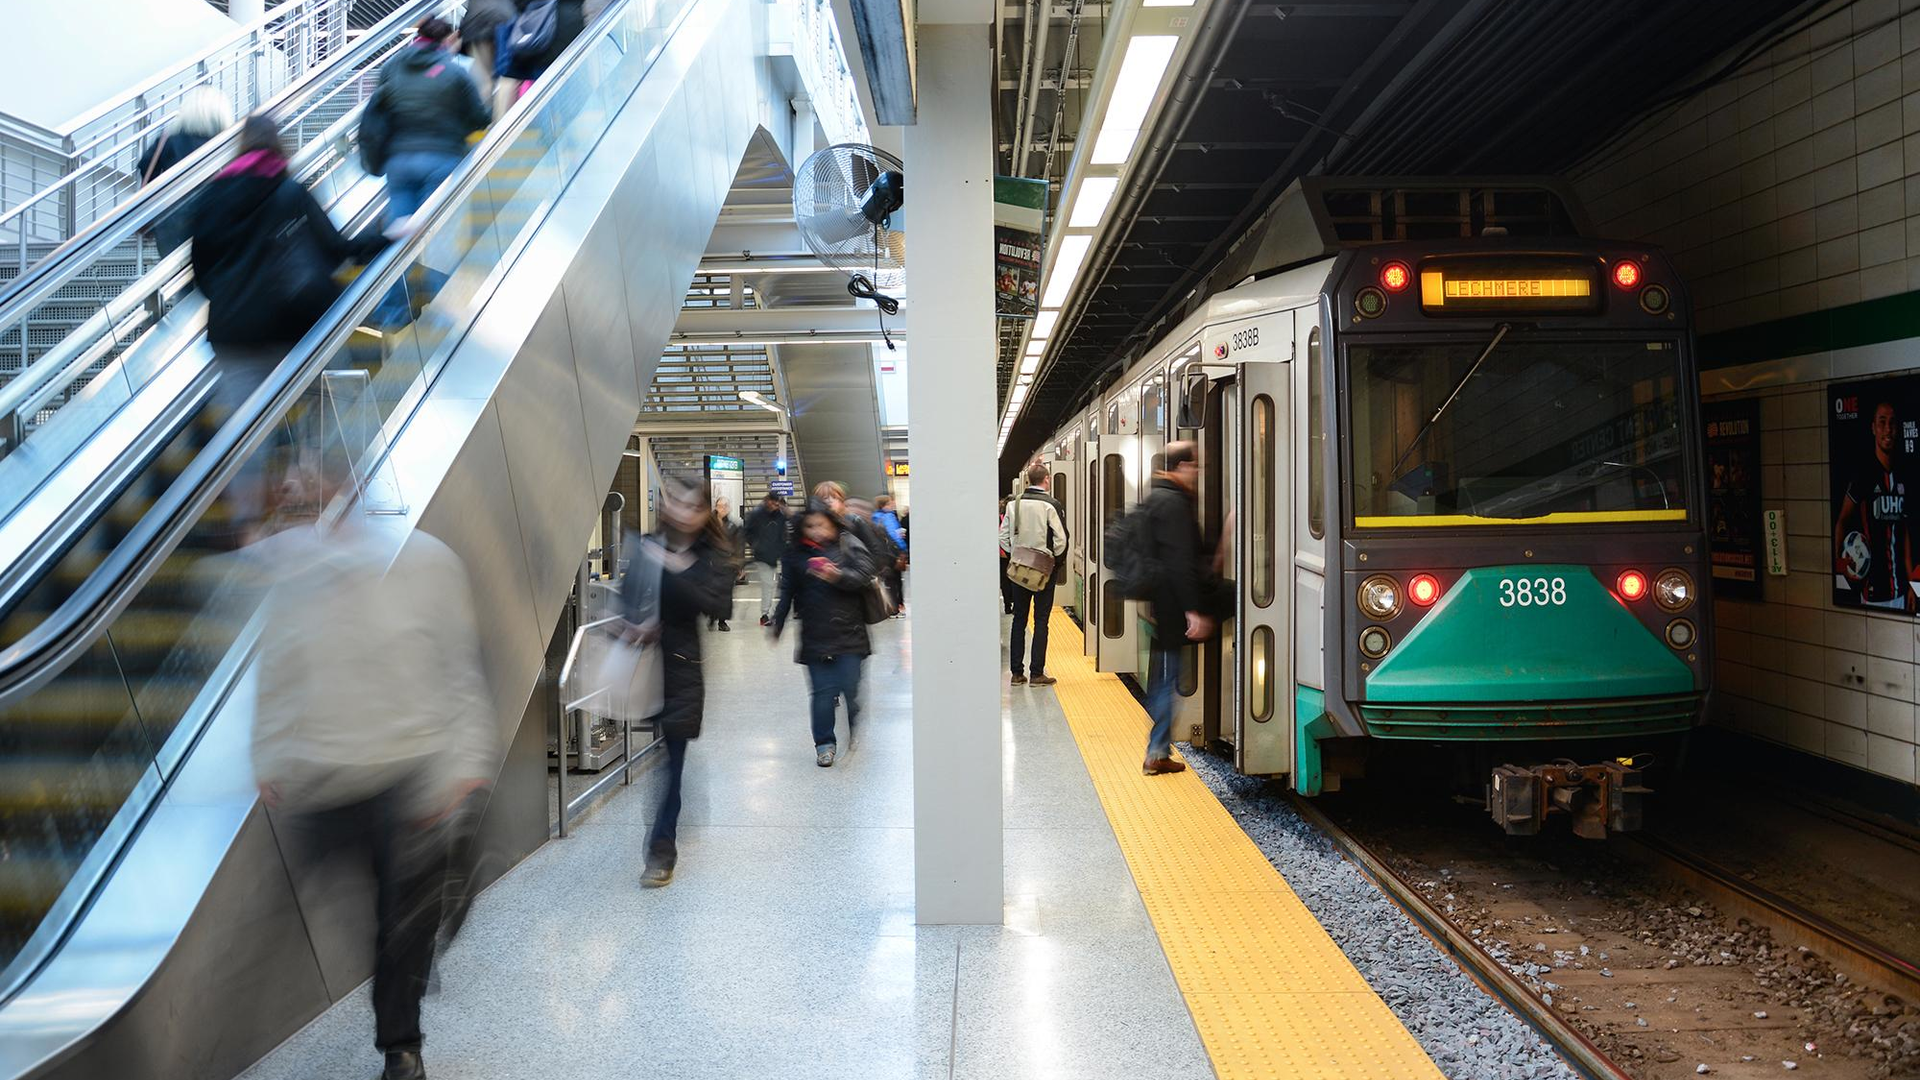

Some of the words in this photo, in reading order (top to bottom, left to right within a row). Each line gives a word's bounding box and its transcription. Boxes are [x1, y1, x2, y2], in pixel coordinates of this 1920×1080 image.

[1446, 281, 1541, 296] LECHMERE
[1233, 327, 1259, 351] 3838B
[1835, 398, 1859, 414] ONE
[1719, 419, 1750, 437] REVOLUTION
[1903, 428, 1919, 438] DAVIES
[1880, 496, 1904, 514] UHC
[1499, 577, 1567, 607] 3838
